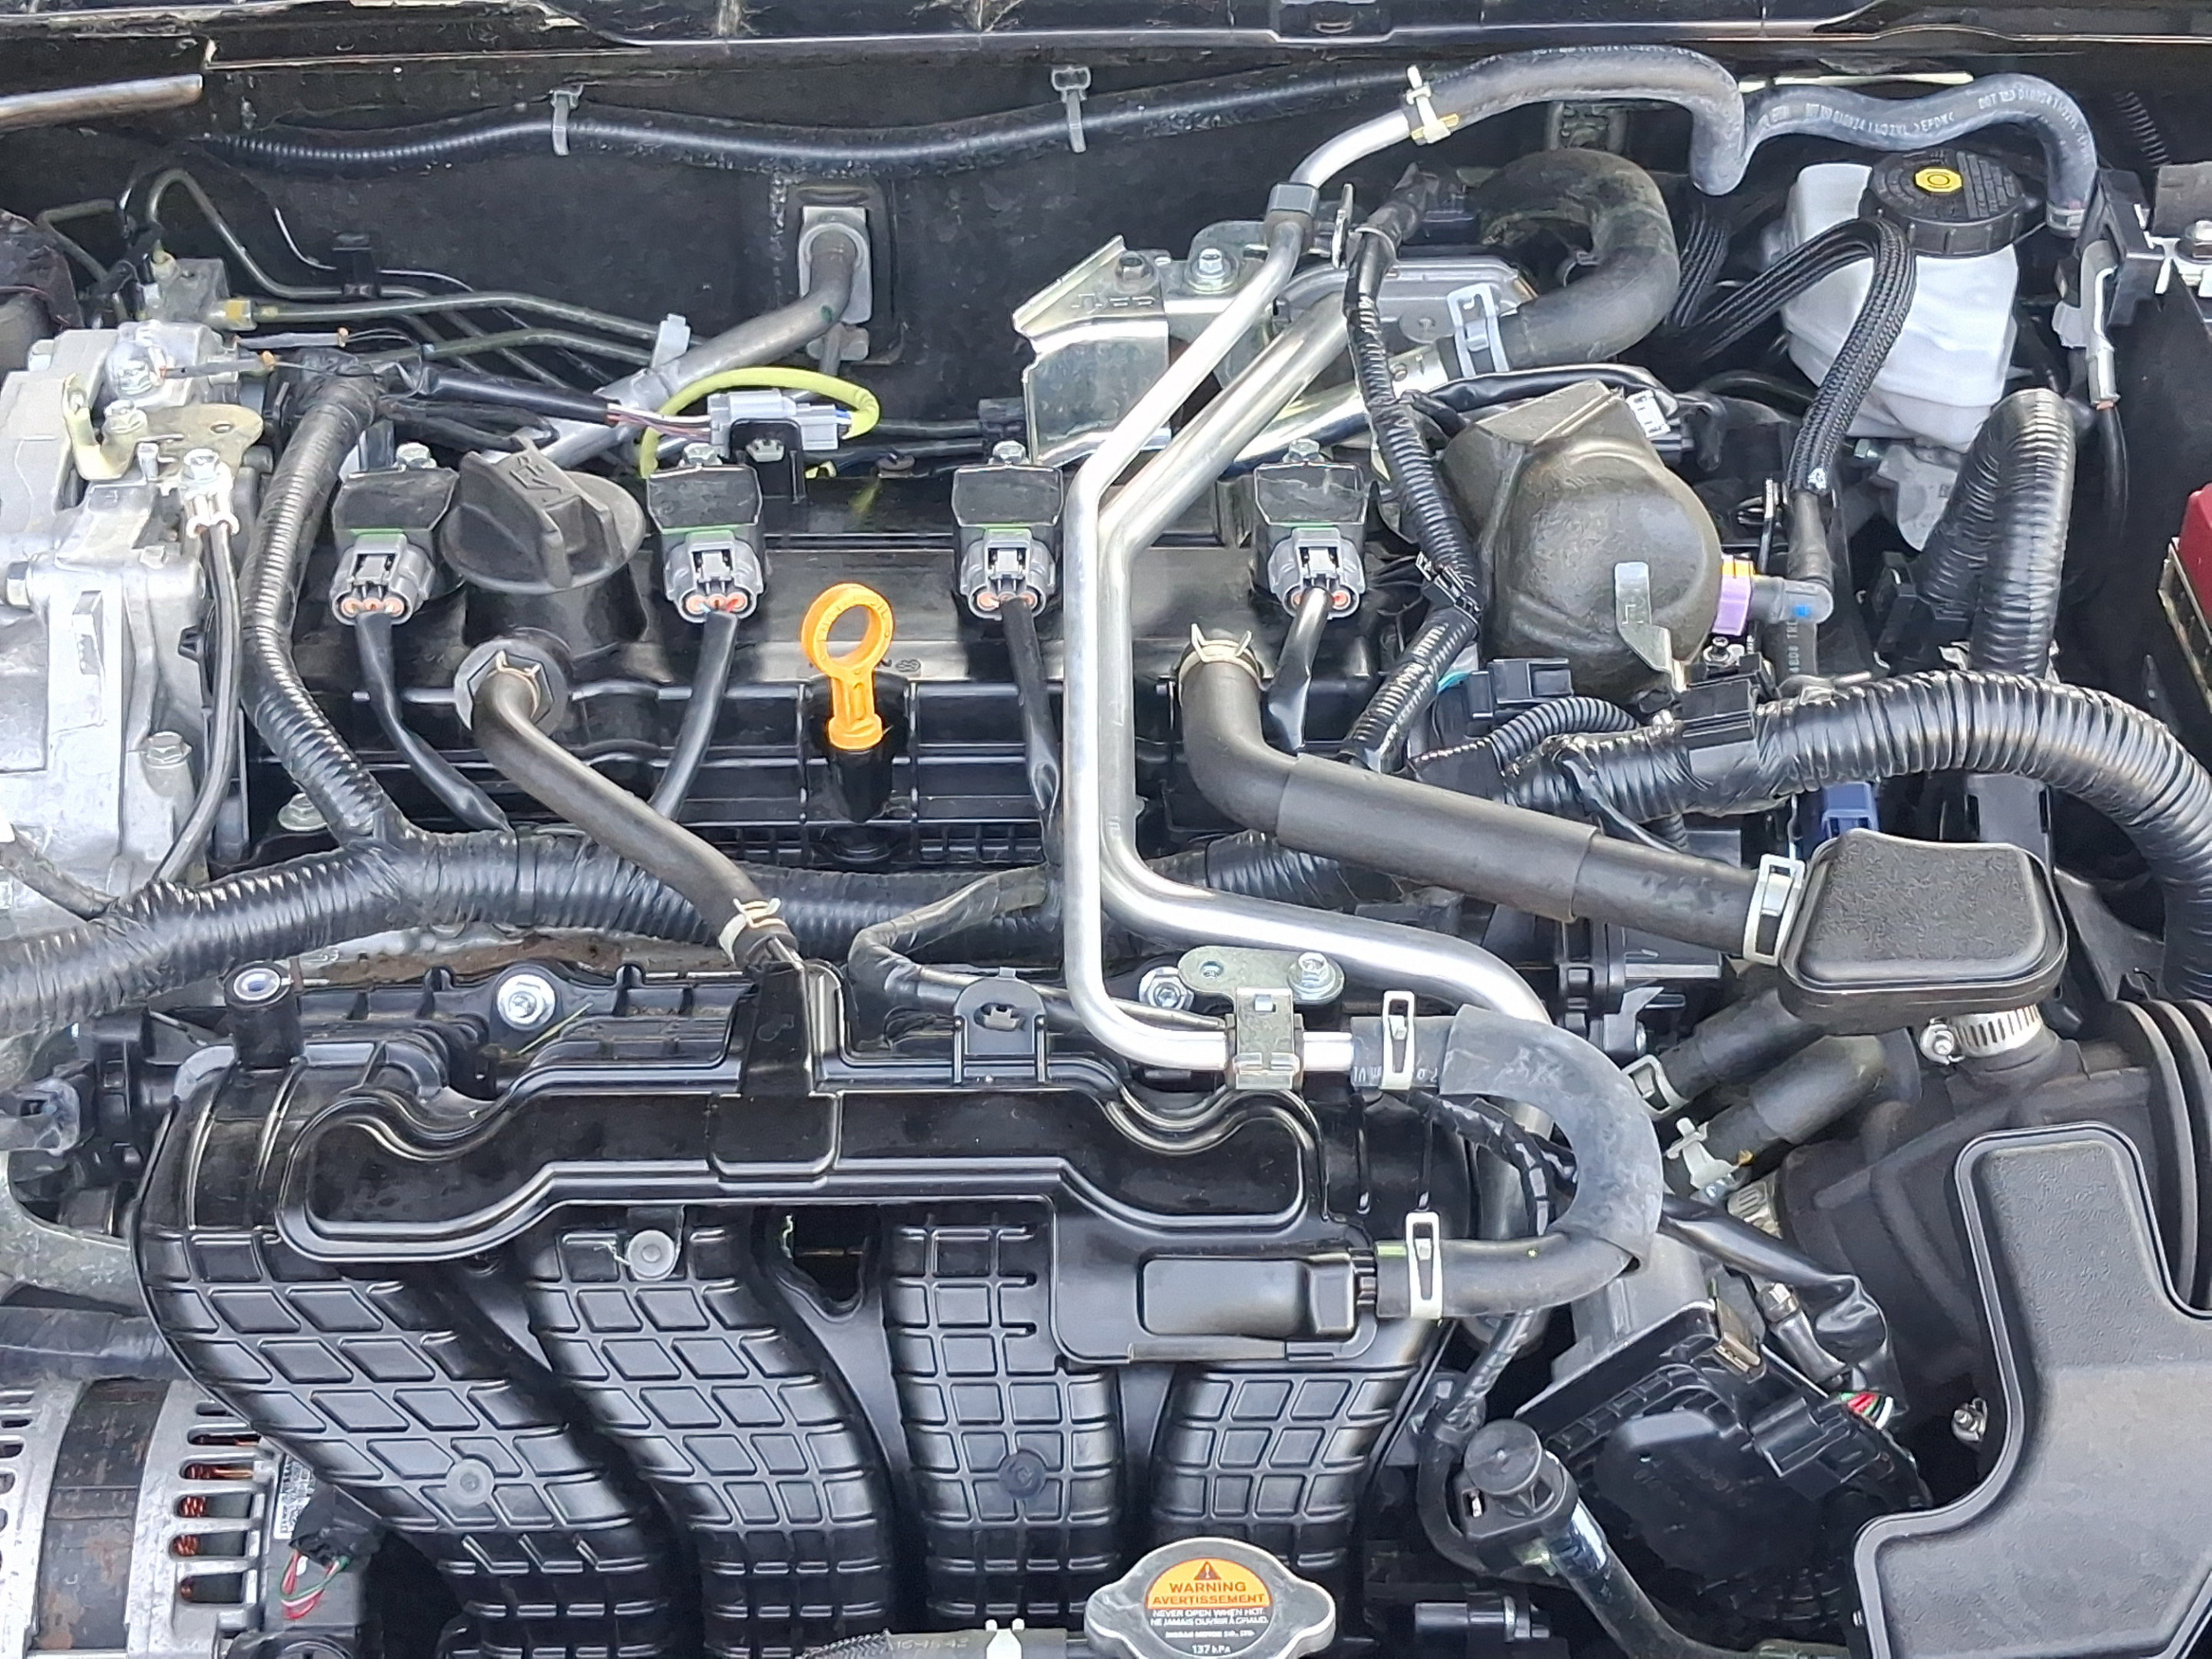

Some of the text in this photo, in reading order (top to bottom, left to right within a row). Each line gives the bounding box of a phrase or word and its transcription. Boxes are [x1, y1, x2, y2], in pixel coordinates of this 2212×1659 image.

[1169, 1581, 1247, 1593] WARNING
[1152, 1594, 1265, 1605] AVERTISSEMENT
[1152, 1609, 1184, 1618] NEVER
[1184, 1609, 1212, 1618] OPEN
[1192, 1644, 1211, 1654] 137
